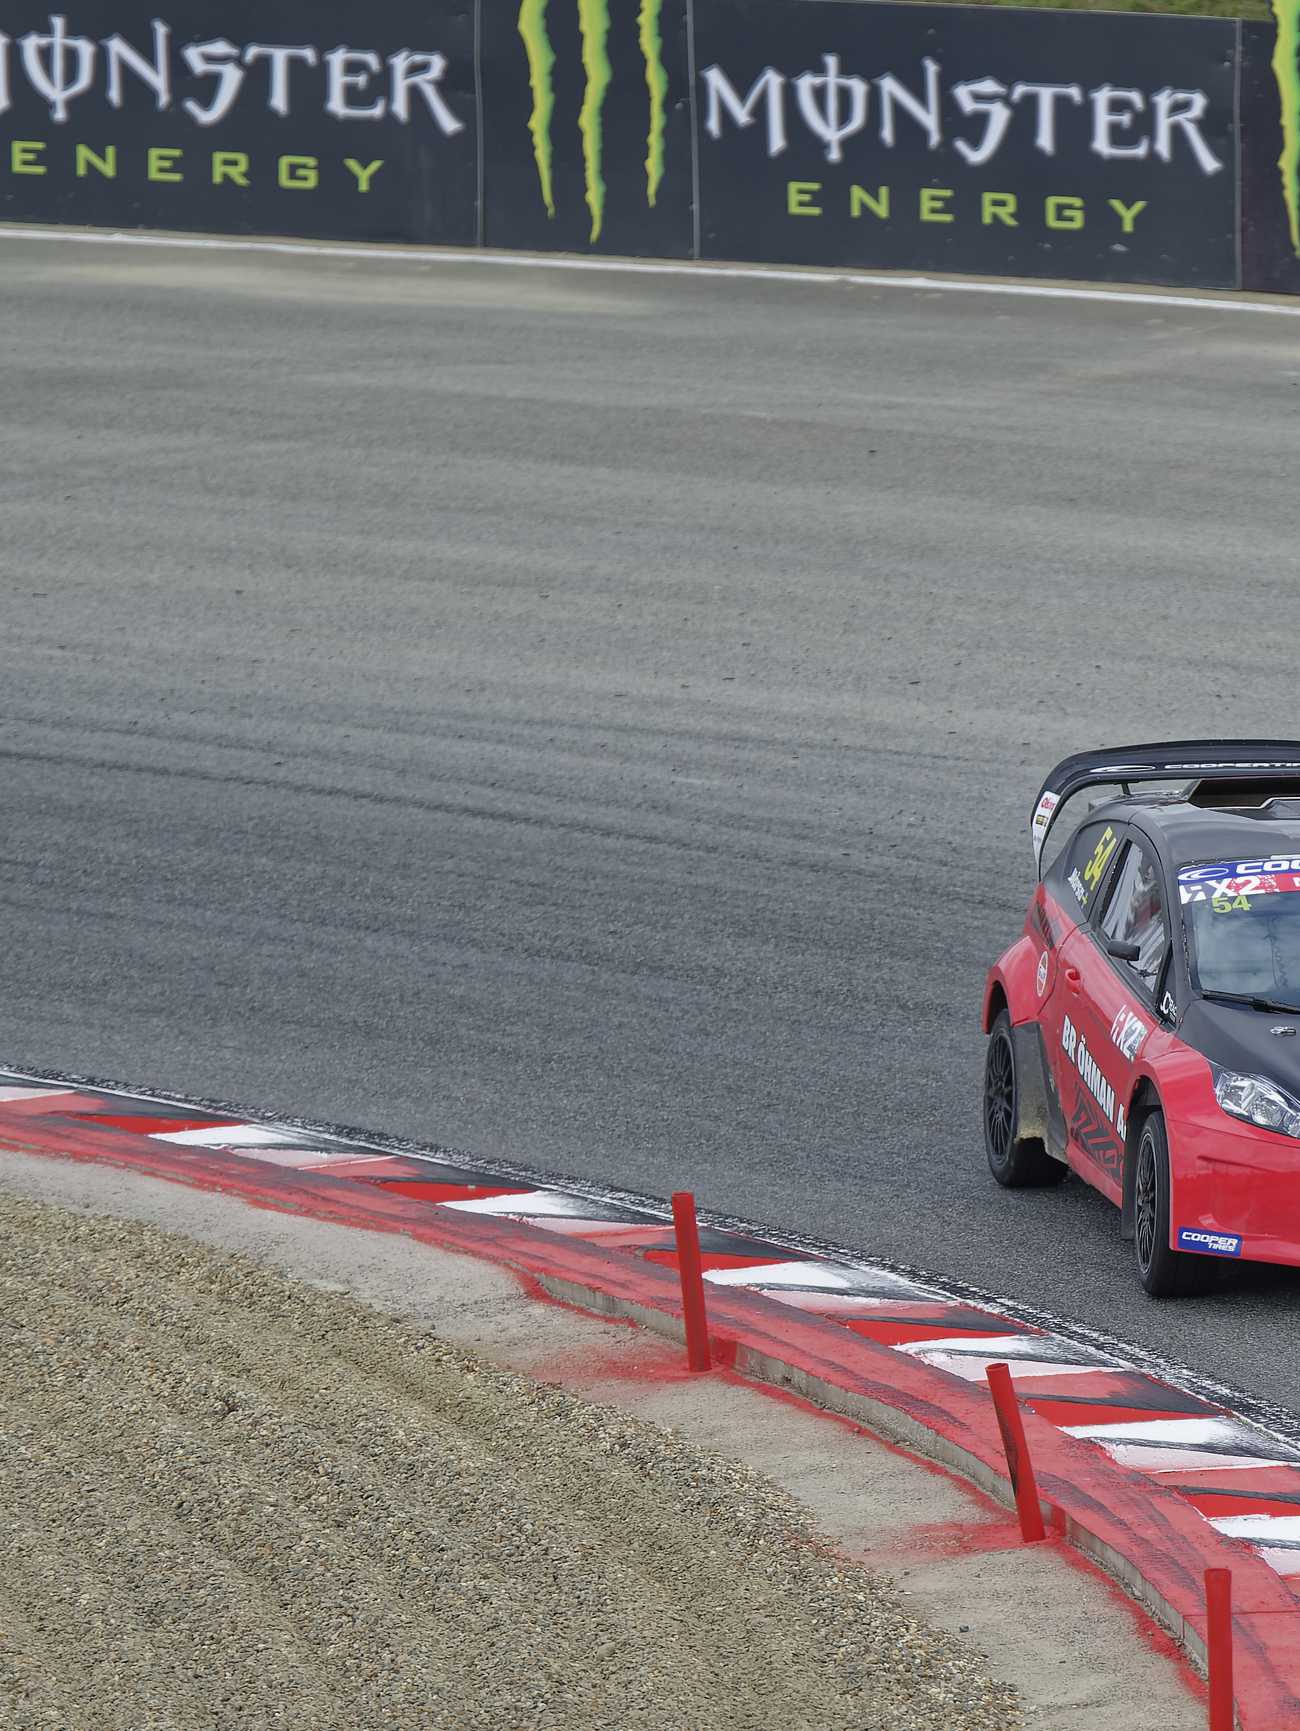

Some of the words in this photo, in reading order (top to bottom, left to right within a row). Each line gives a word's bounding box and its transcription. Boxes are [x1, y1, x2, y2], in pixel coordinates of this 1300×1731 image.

[0, 15, 464, 137] ONSTER
[701, 52, 1224, 175] MONSTER
[10, 140, 385, 192] ENERGY
[787, 181, 1148, 233] ENERGY
[1212, 895, 1253, 913] 54
[1182, 1232, 1239, 1246] COOPER
